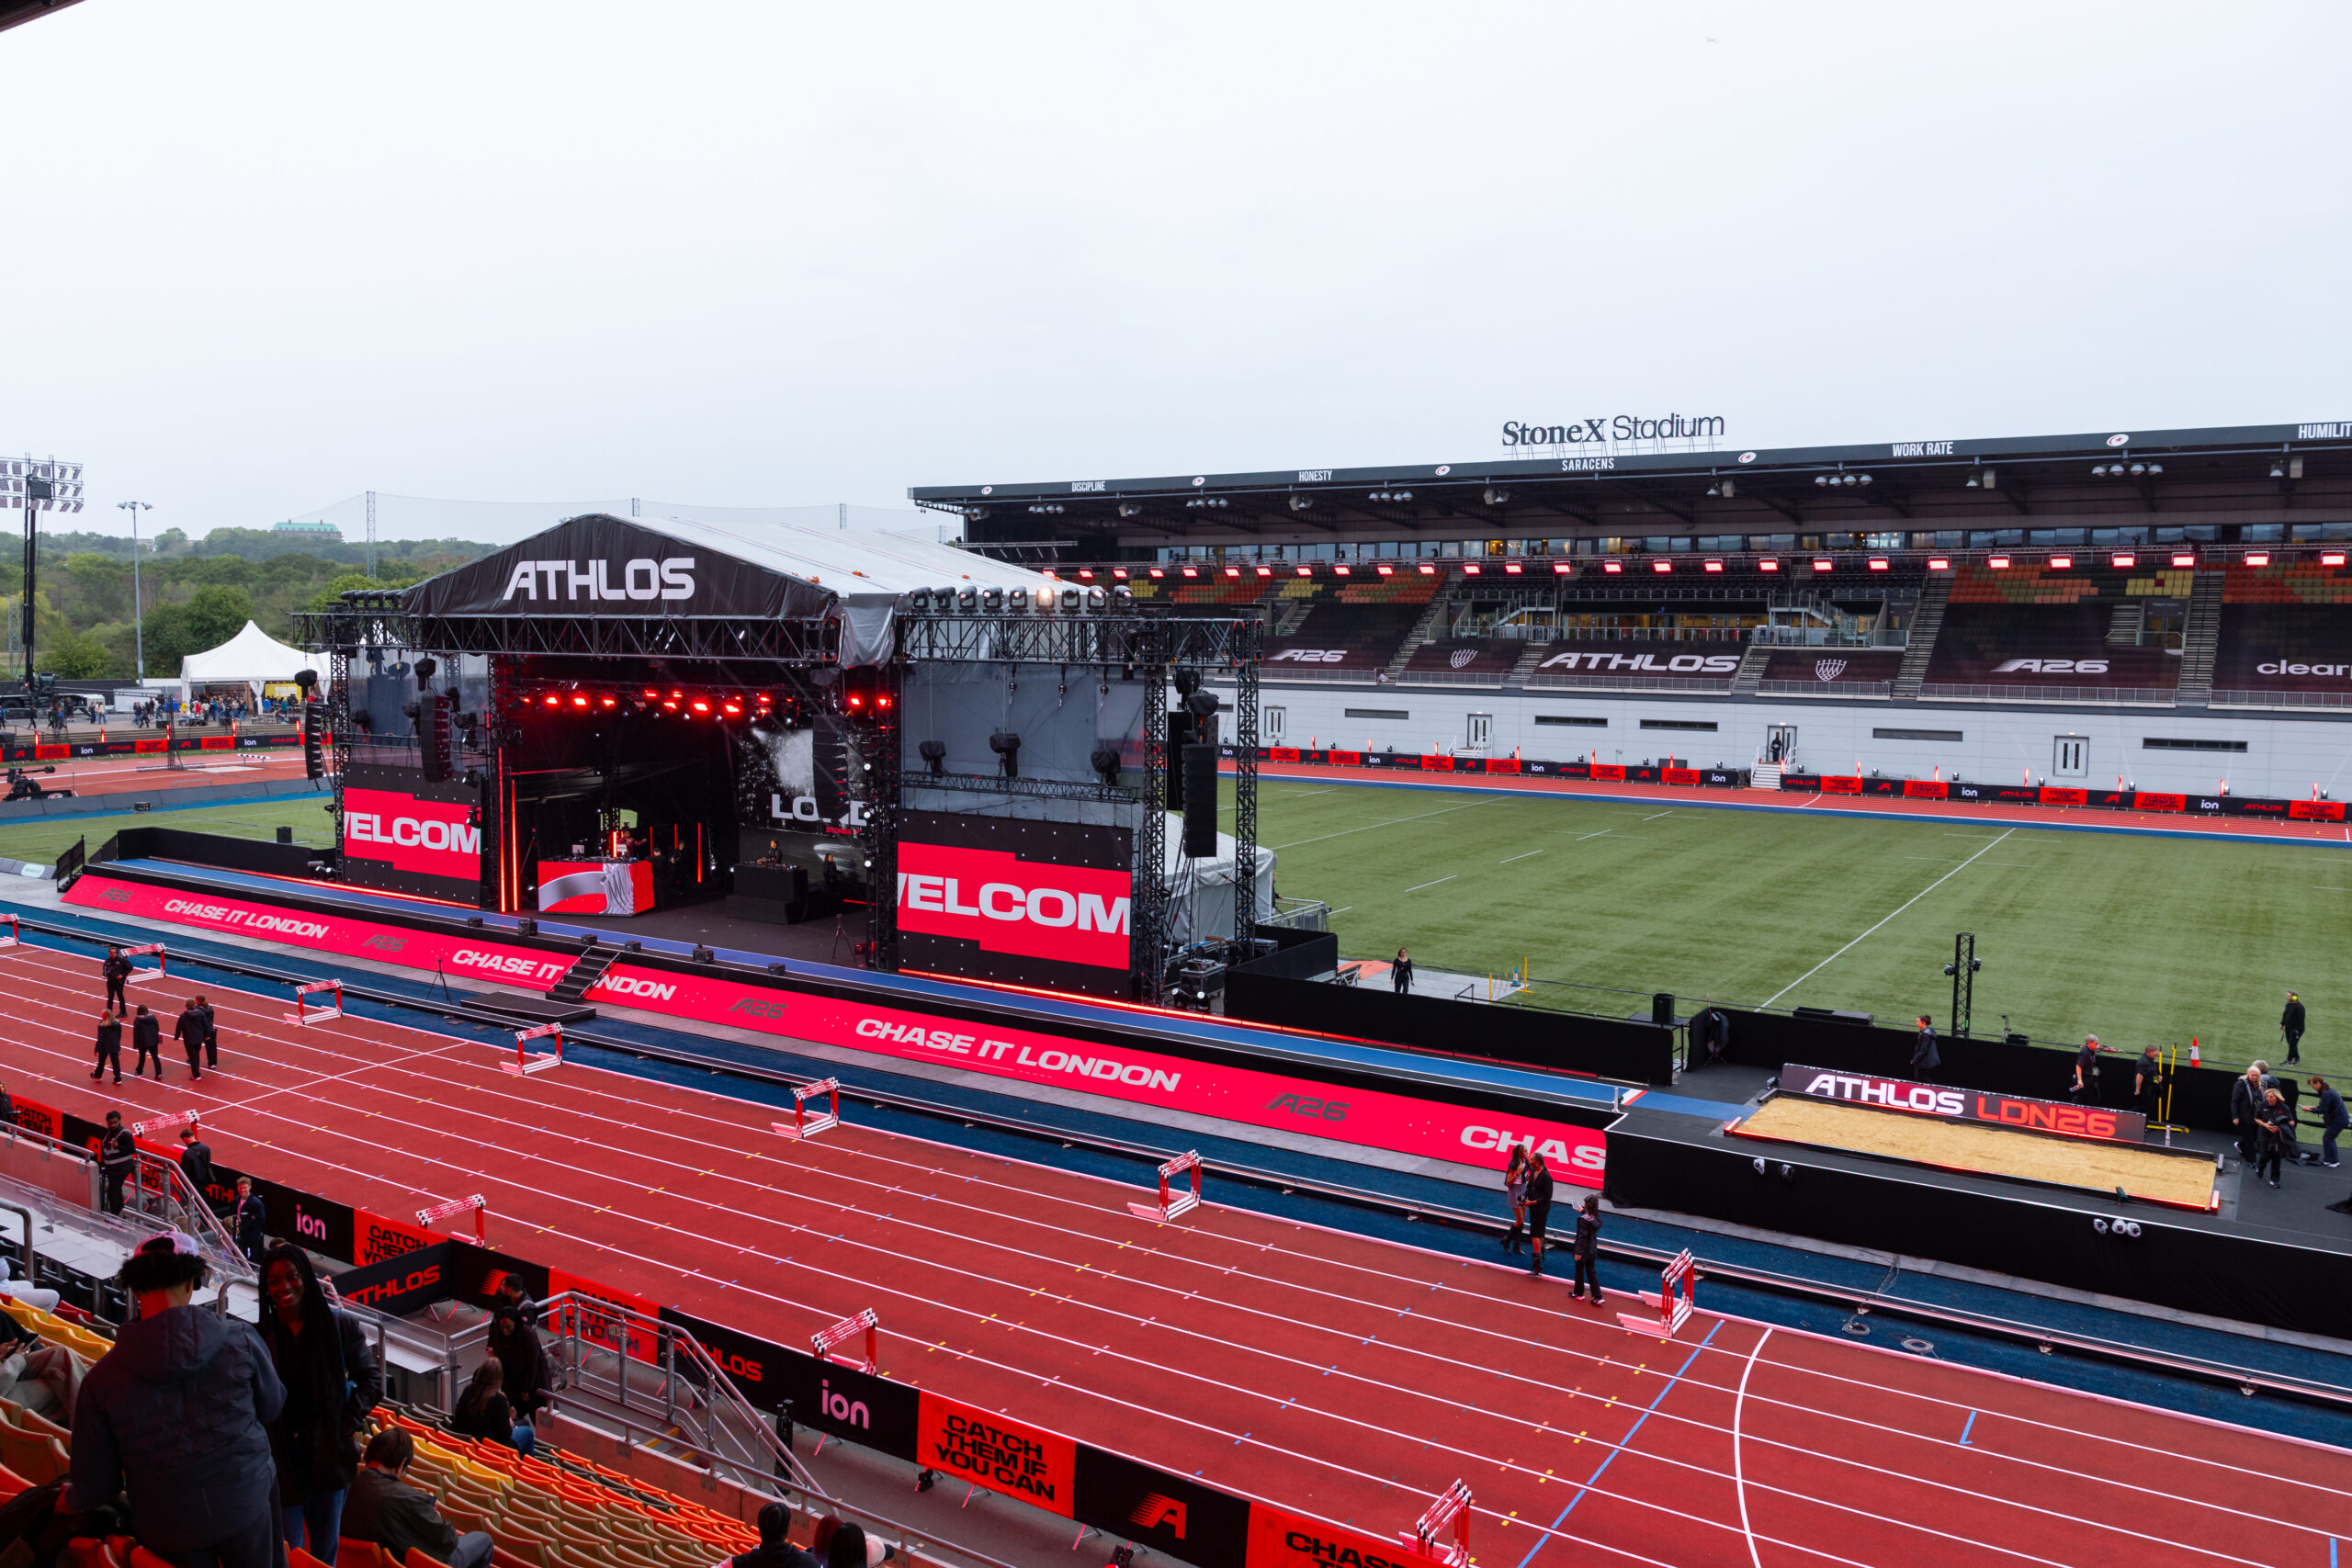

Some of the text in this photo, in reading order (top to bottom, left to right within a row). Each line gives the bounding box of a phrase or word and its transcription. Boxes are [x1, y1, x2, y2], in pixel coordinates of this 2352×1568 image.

[1502, 412, 1724, 446] StoneX Stadium
[1893, 441, 1954, 457] WORK RATE
[1562, 457, 1615, 471] SARACENS
[1071, 480, 1105, 492] DISCIPLINE
[1298, 469, 1332, 482] HONESTY
[503, 558, 695, 600] ATHLOS
[1266, 649, 1348, 663] A26
[1539, 651, 1741, 672] ATHLOS
[1990, 659, 2109, 673] A26
[2256, 660, 2352, 680] clear
[81, 746, 94, 755] ion
[1222, 747, 1233, 755] ion
[1369, 755, 1381, 763] ion
[1531, 763, 1544, 773] ion
[1712, 773, 1726, 782] ion
[1962, 787, 1978, 796] ion
[2200, 799, 2220, 809] ion
[97, 888, 134, 903] A26
[164, 898, 330, 939] CHASE IT LONDON
[362, 935, 409, 952] A26
[452, 949, 677, 1001] CHASE IT NDON
[729, 998, 788, 1020] A26
[855, 1019, 1182, 1092] CHASE IT LONDON
[16, 1104, 52, 1126] CATCH
[1264, 1092, 1351, 1122] A26
[1804, 1073, 2117, 1138] ATHLOS LDN26
[1460, 1125, 1607, 1170] CHAS
[296, 1204, 326, 1240] ion
[821, 1379, 870, 1430] ion
[946, 1415, 1043, 1461] CATCH
[942, 1428, 1047, 1477] THEM IF
[934, 1443, 1055, 1502] YOU CAN
[1285, 1531, 1408, 1568] CHAS
